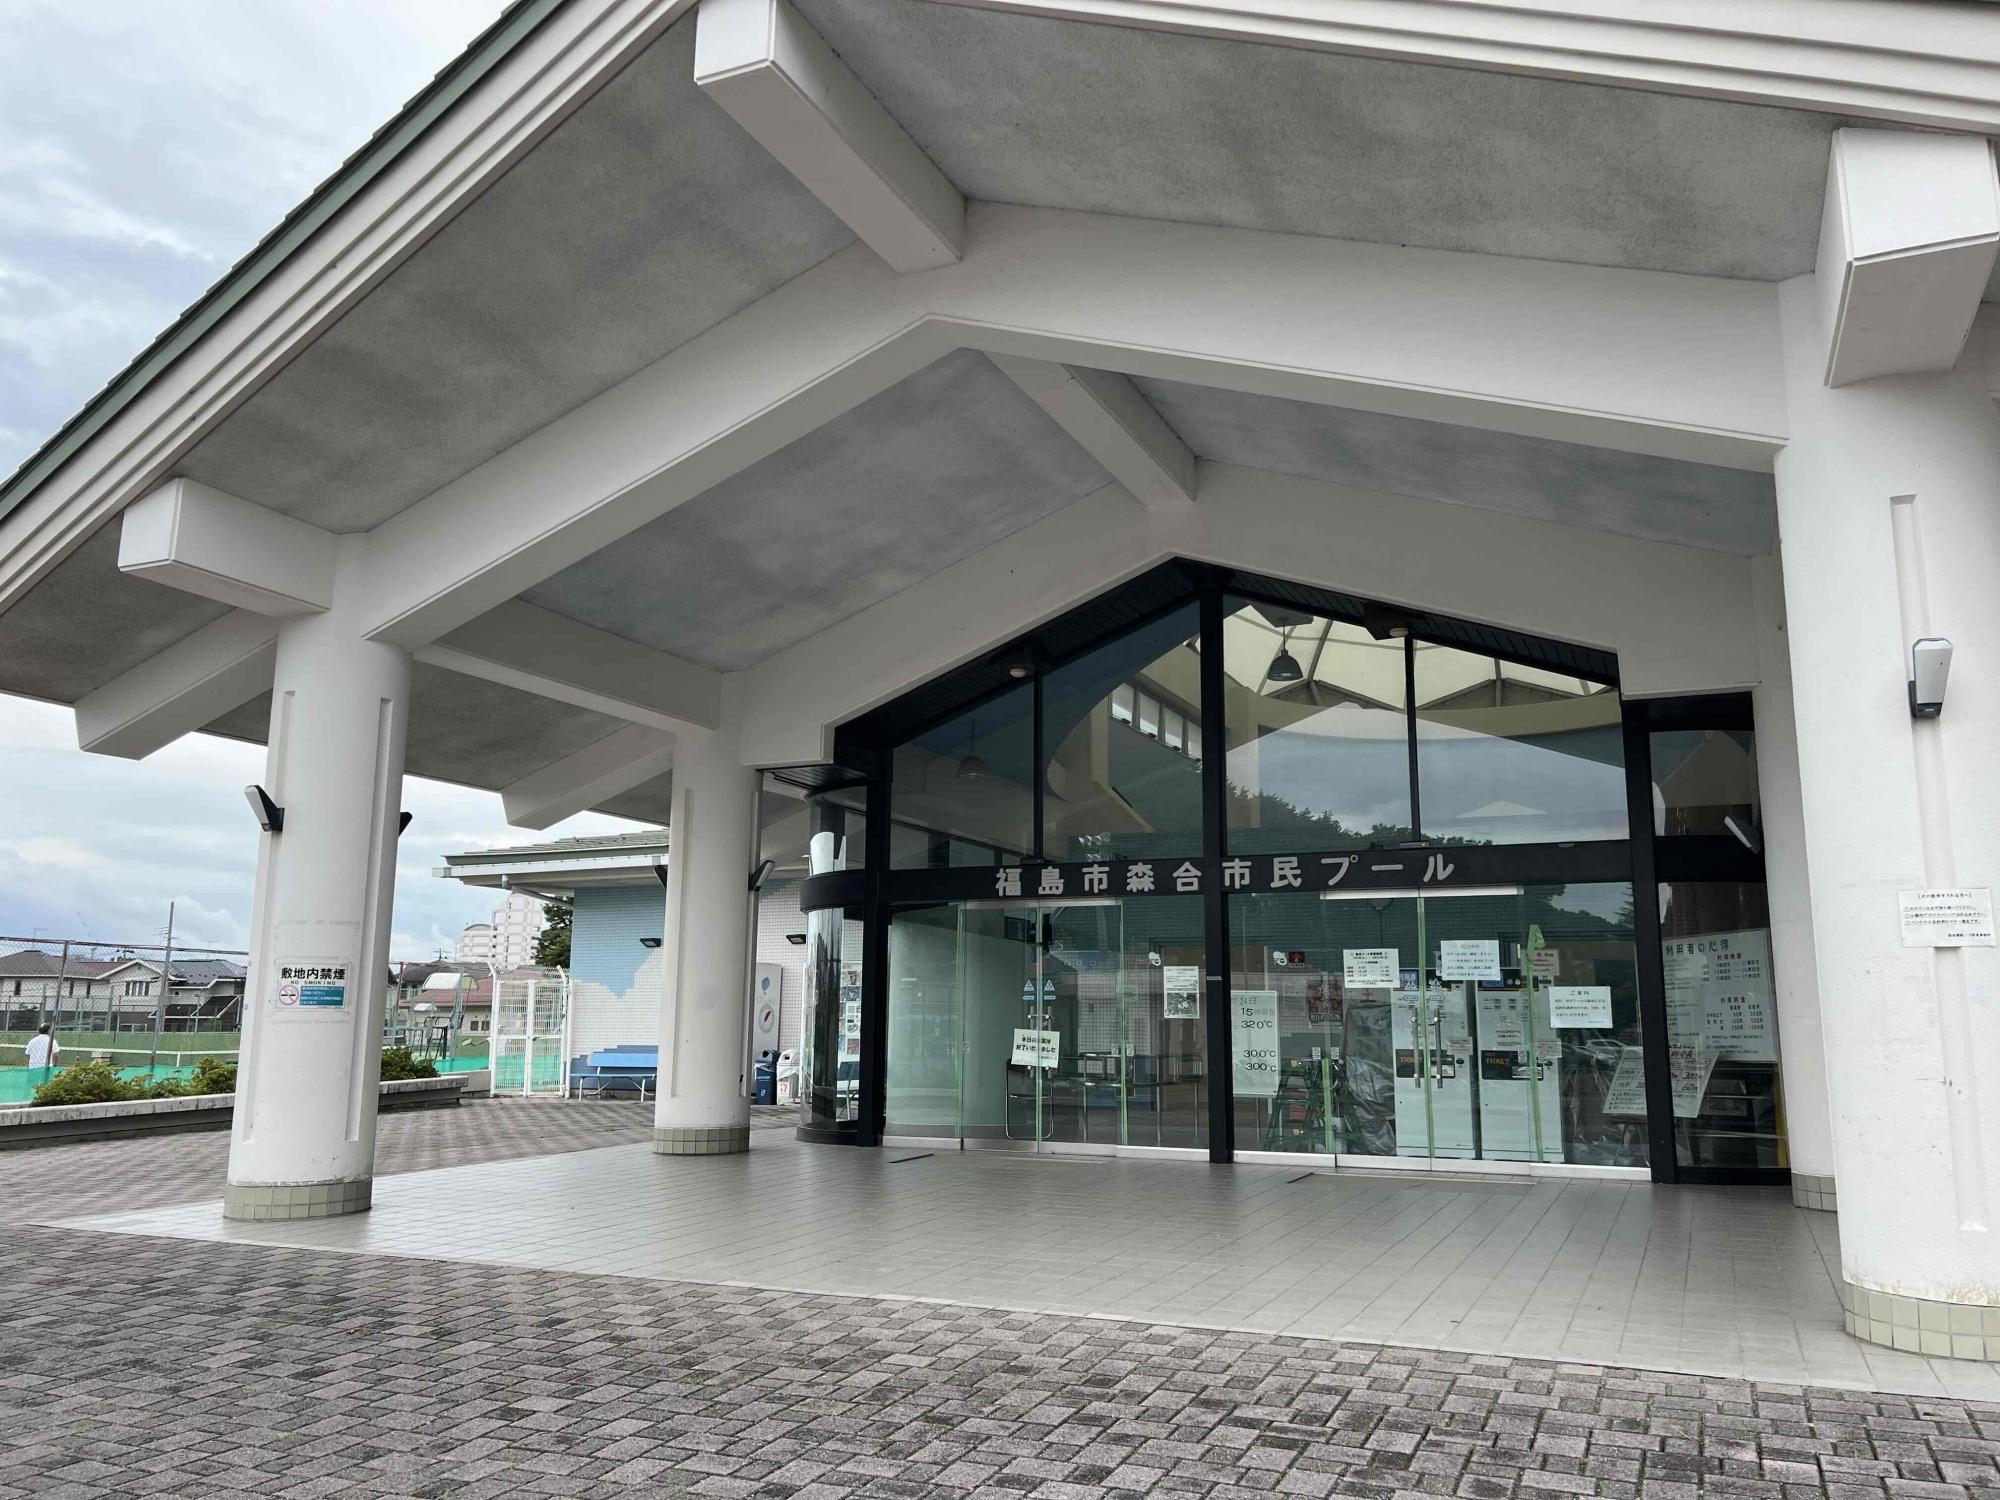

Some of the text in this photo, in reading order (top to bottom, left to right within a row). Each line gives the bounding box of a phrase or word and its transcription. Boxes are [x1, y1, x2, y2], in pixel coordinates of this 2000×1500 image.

[995, 853, 1455, 897] 福島市森合市民プール
[280, 967, 346, 980] 敷地内禁煙
